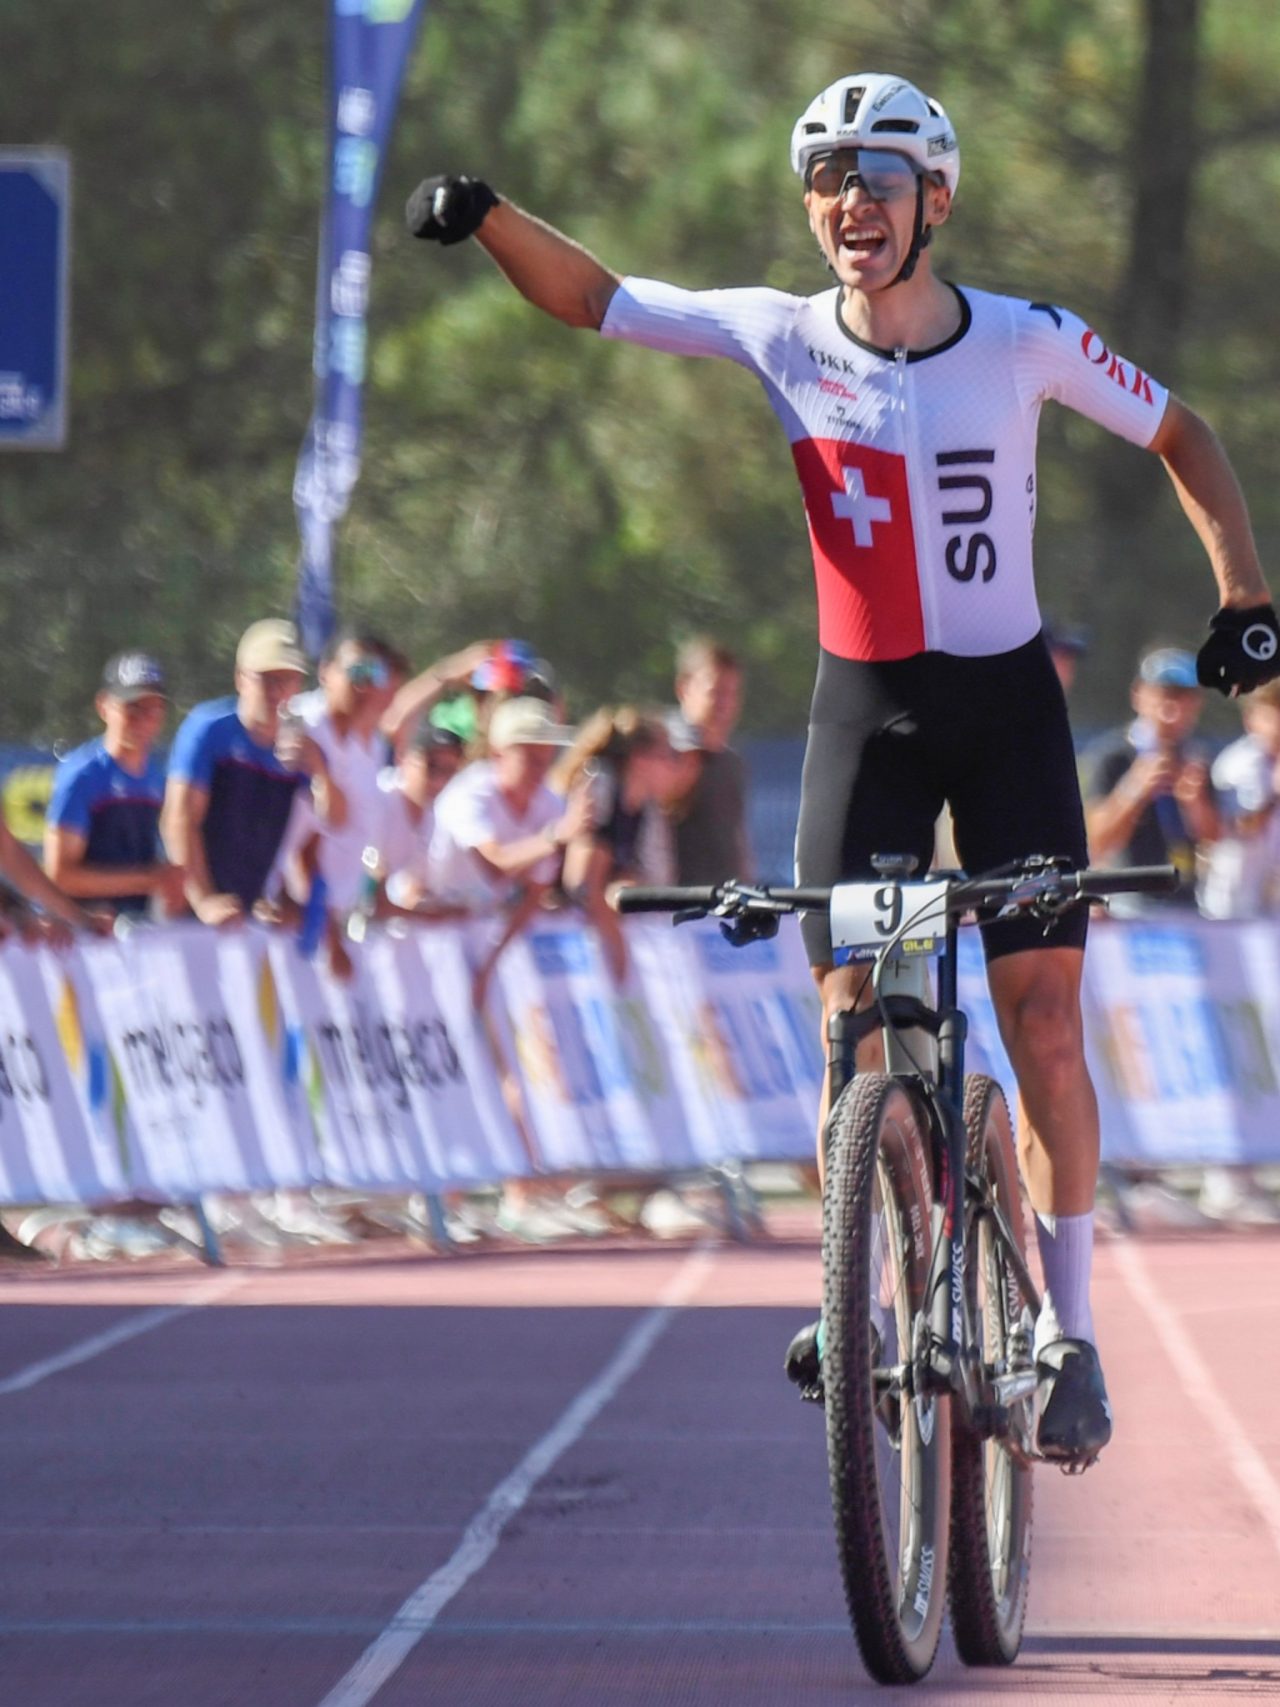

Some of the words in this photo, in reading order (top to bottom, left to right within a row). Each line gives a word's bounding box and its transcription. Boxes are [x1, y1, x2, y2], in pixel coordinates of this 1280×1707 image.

[1081, 327, 1154, 407] OKK
[936, 449, 996, 584] SUI
[873, 886, 903, 936] 9
[951, 1242, 965, 1304] SWISS
[916, 1546, 934, 1592] SWISS
